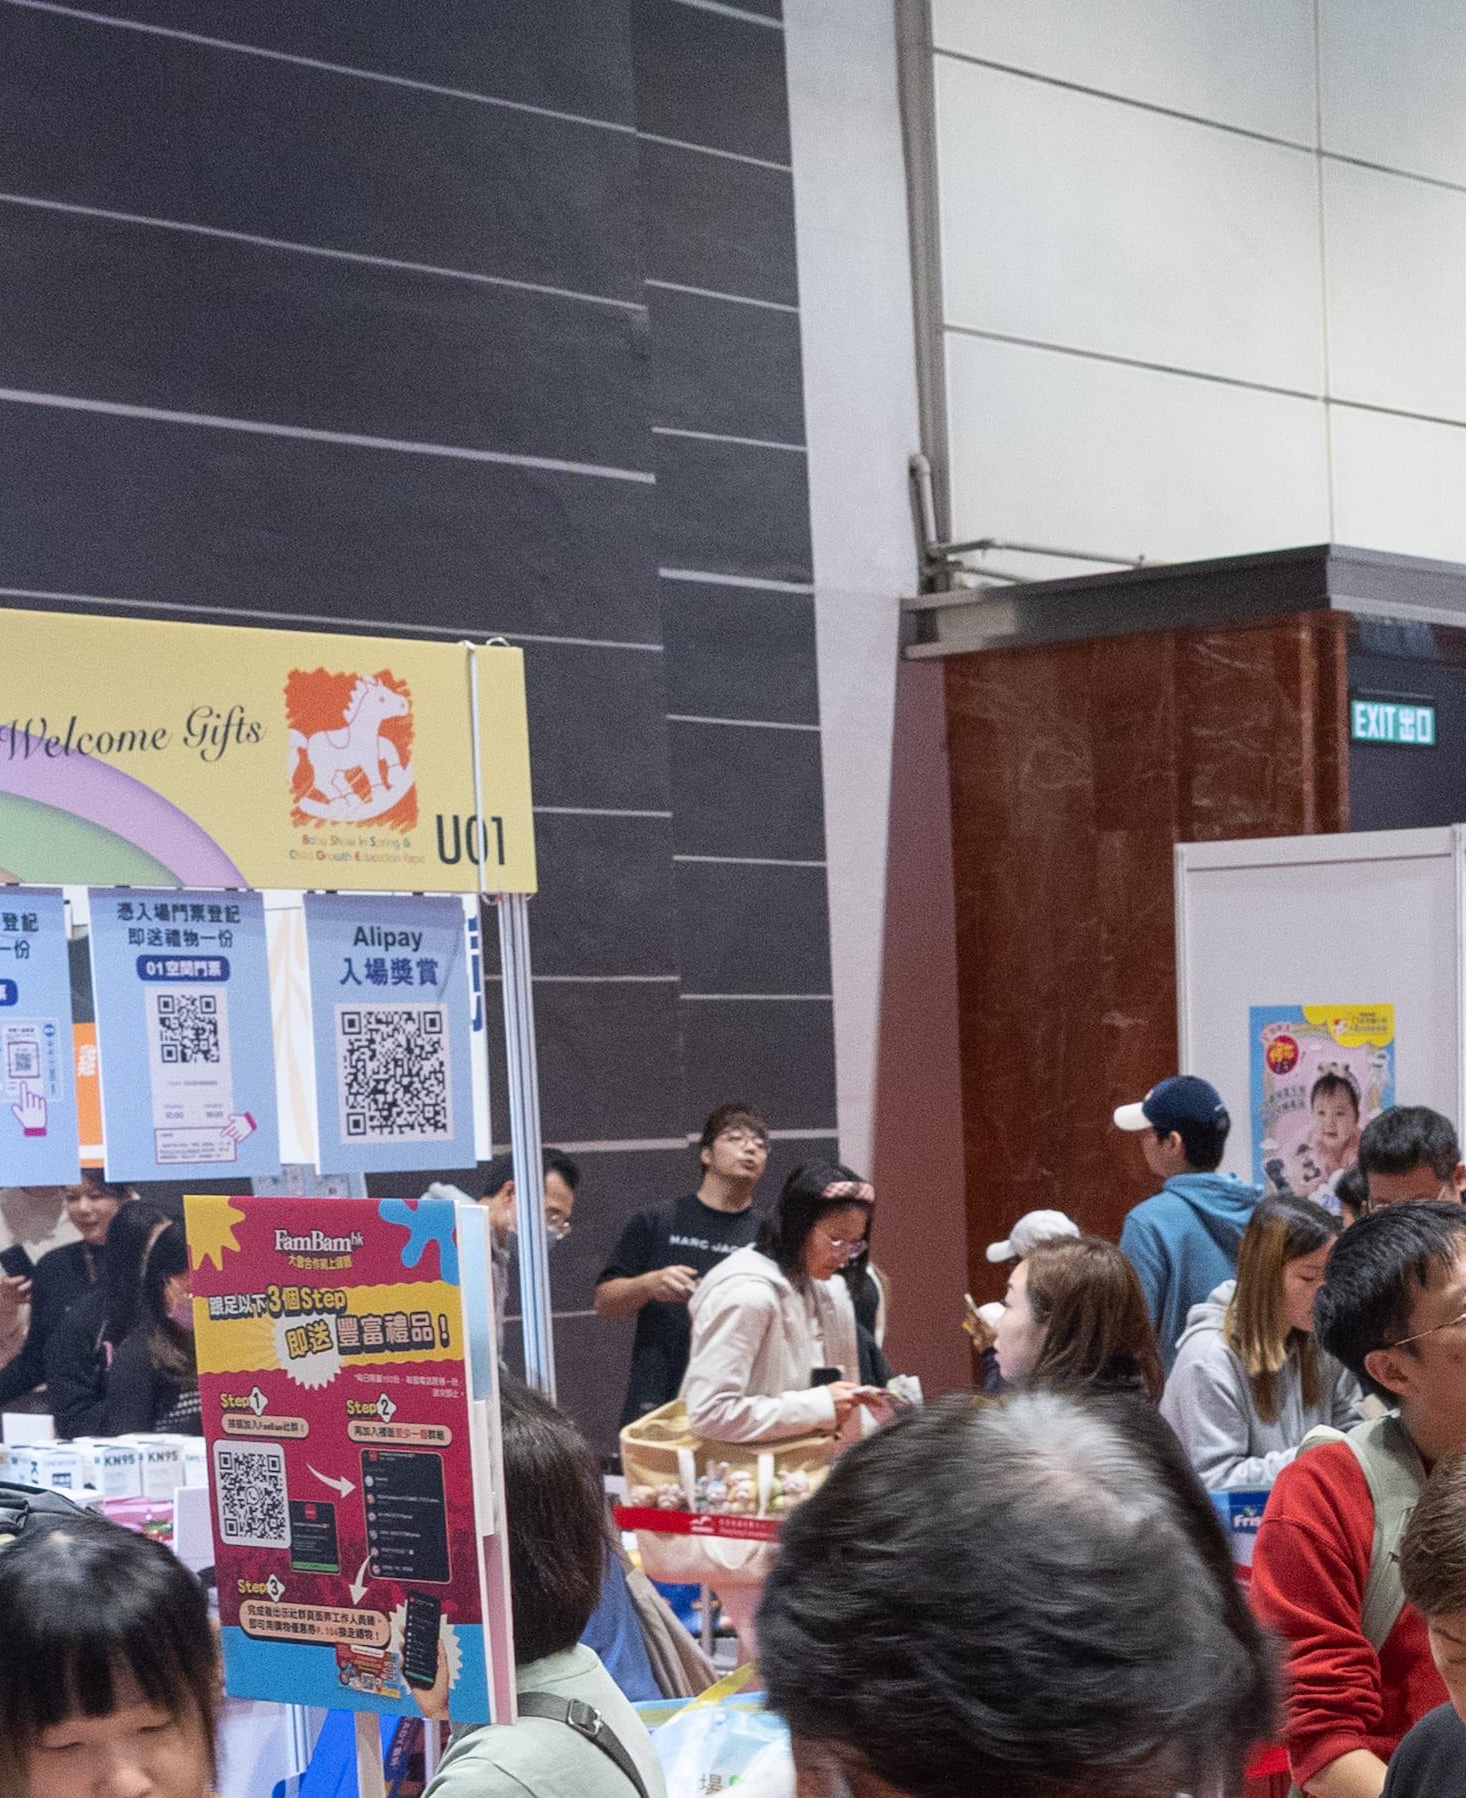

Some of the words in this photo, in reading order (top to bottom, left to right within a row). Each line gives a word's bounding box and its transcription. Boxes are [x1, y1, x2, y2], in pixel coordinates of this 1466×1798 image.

[182, 706, 265, 760] Gifts
[1354, 702, 1396, 739] EXIT
[1398, 704, 1434, 742] 出口
[436, 814, 506, 866] U01
[117, 902, 241, 925] 憑入場門票登記
[128, 928, 234, 949] 即送禮物一份
[353, 925, 424, 952] Alipay
[340, 957, 439, 987] 入場獎賞
[669, 1235, 709, 1250] MARC
[286, 1320, 332, 1358] 即送
[220, 1392, 250, 1409] Step
[347, 1399, 378, 1416] Step
[104, 1454, 135, 1467] KN95
[148, 1450, 179, 1463] KN95
[237, 1578, 268, 1594] Step
